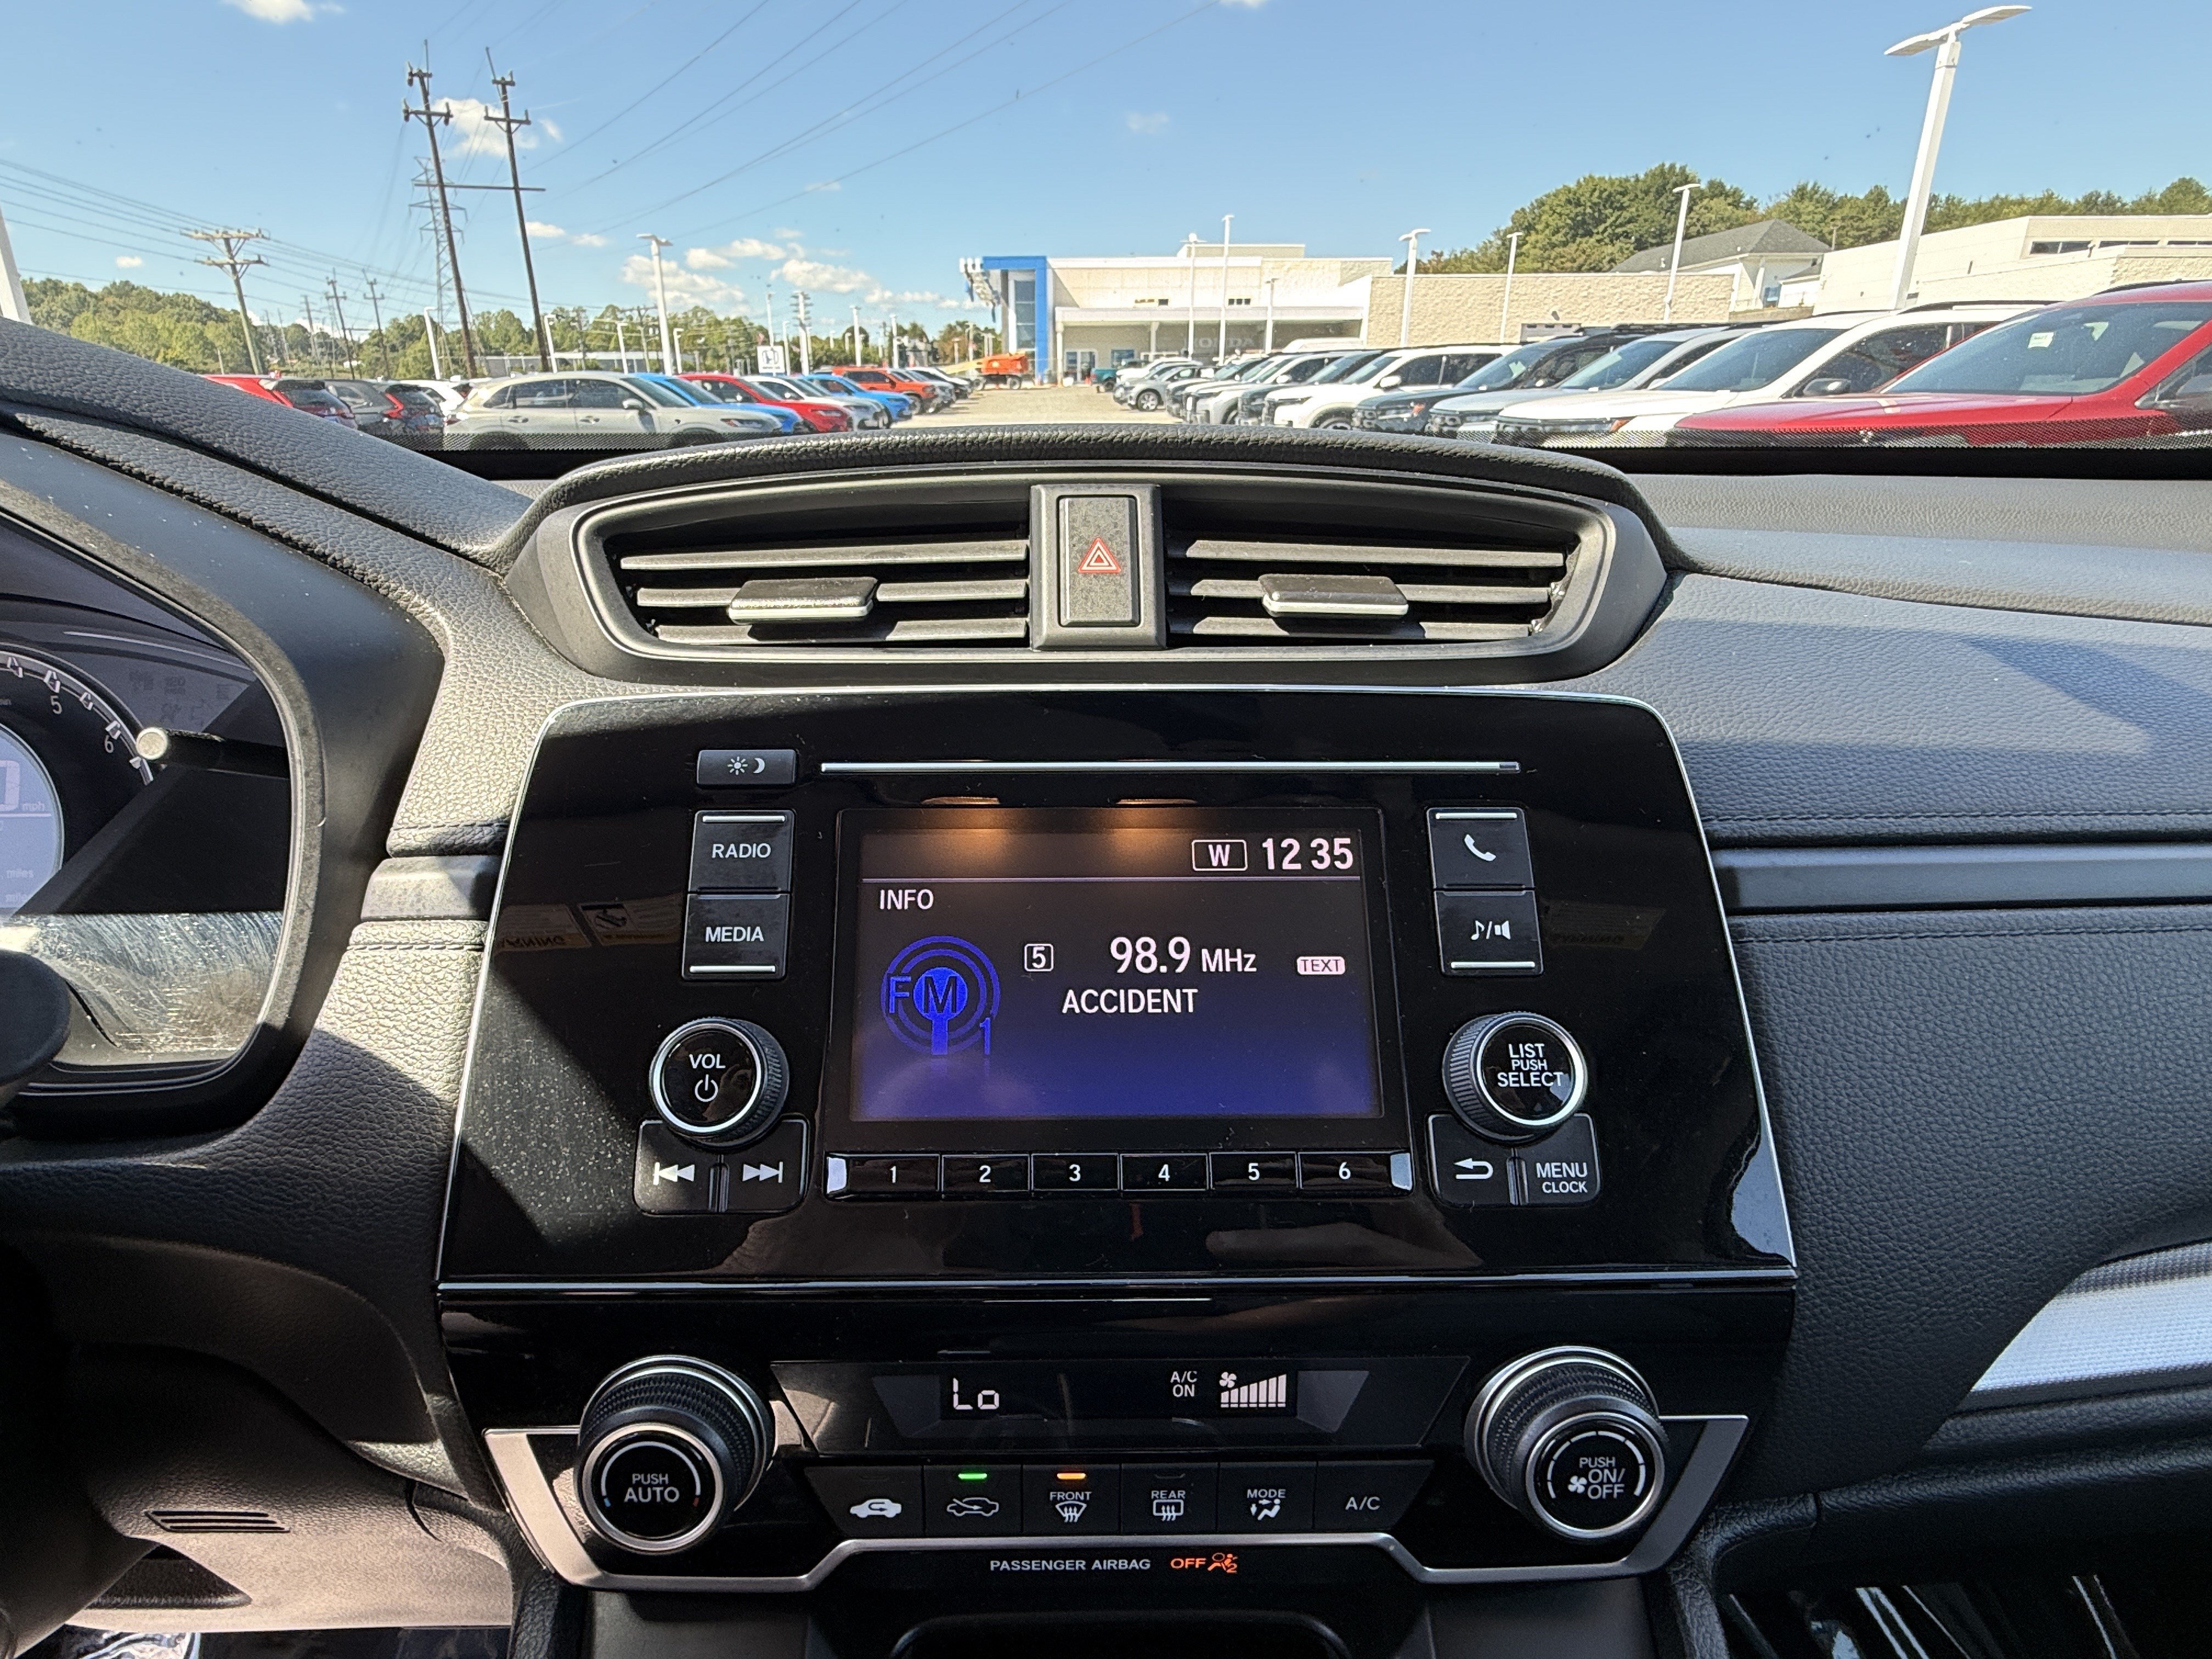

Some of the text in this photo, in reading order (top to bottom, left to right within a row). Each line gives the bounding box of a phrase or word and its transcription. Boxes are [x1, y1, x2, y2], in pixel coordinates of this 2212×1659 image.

[50, 695, 63, 714] 5
[104, 735, 115, 754] 6
[712, 843, 771, 859] RADIO
[1208, 844, 1231, 866] W
[879, 889, 934, 910] INFO
[706, 926, 764, 943] MEDIA
[1031, 936, 1341, 974] 5 98.9 MHz TEXT
[1062, 989, 1199, 1014] ACCIDENT
[1508, 1043, 1545, 1058] LIST
[689, 1053, 726, 1069] VOL
[1511, 1059, 1548, 1071] PUSH
[1497, 1073, 1564, 1088] SELECT
[890, 1165, 896, 1183] 1
[979, 1165, 991, 1183] 2
[1069, 1164, 1081, 1182] 3
[1158, 1164, 1170, 1182] 4
[1248, 1163, 1260, 1181] 5
[1339, 1161, 1351, 1180] 6
[1536, 1162, 1588, 1178] MENU
[1542, 1181, 1588, 1194] CLOCK
[1170, 1370, 1197, 1383] A/C
[952, 1378, 1000, 1410] Lo
[1172, 1384, 1195, 1398] ON
[1579, 1456, 1616, 1468] PUSH
[632, 1473, 669, 1485] PUSH
[1588, 1468, 1625, 1485] ON/
[624, 1486, 680, 1503] AUTO
[1049, 1491, 1091, 1502] FRONT
[1151, 1490, 1186, 1499] REAR
[1246, 1488, 1286, 1499] MODE
[1587, 1483, 1625, 1499] OFF
[1345, 1496, 1380, 1510] A/C
[990, 1559, 1086, 1571] PASSENGER
[1091, 1559, 1151, 1570] AIRBAG
[1170, 1558, 1207, 1569] OFF
